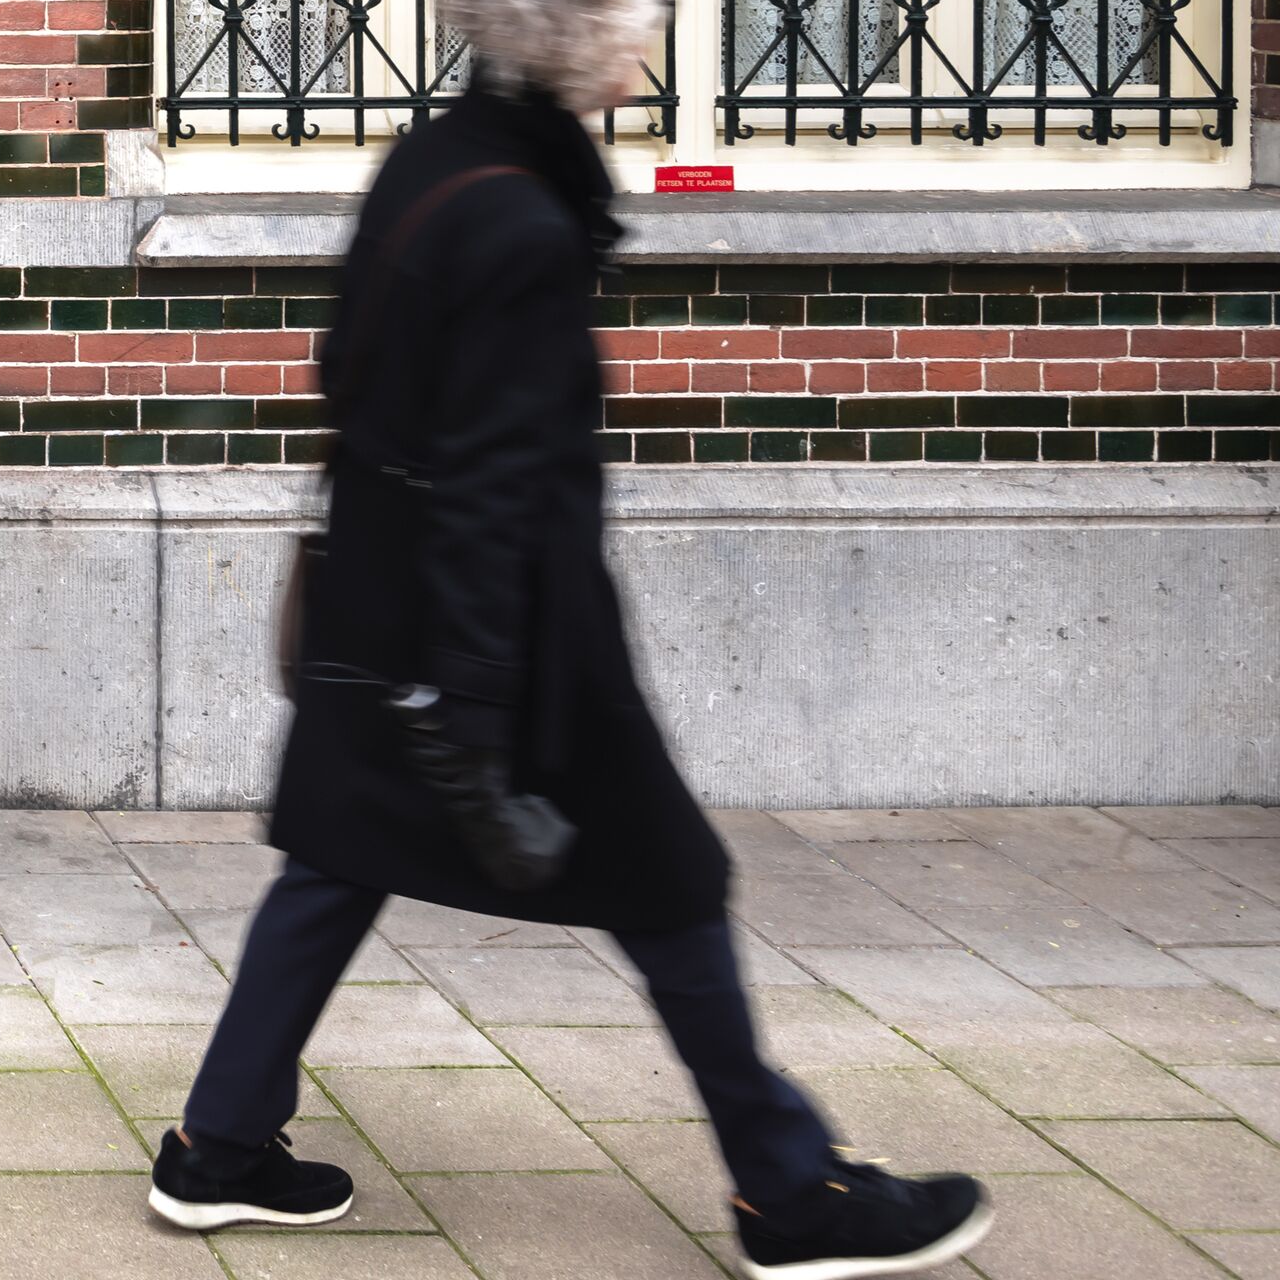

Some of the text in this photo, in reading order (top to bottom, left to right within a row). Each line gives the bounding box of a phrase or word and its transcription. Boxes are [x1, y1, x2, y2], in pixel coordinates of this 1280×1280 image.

[677, 170, 713, 178] VERBODEN
[657, 179, 684, 187] FIETSEN
[686, 179, 696, 187] TE
